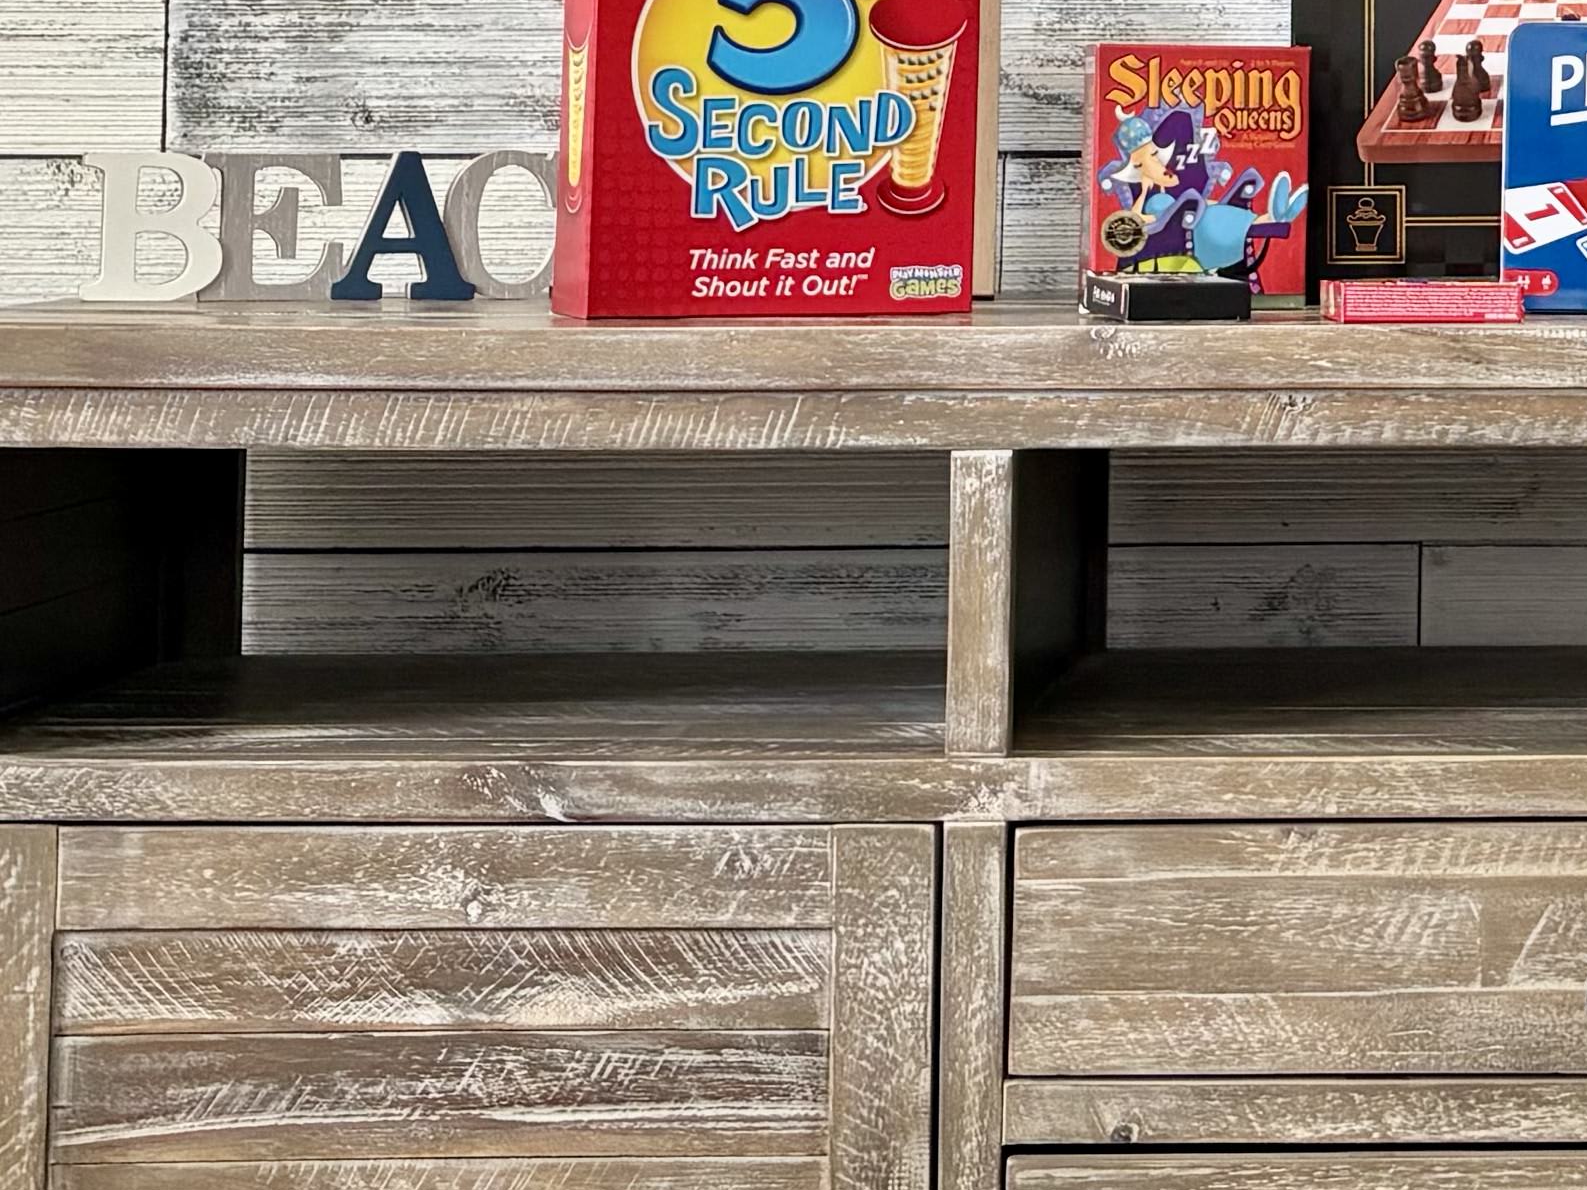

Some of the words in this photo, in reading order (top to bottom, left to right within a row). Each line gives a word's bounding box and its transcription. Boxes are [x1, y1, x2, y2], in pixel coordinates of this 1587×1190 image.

[648, 67, 915, 160] SECOND
[1104, 54, 1302, 141] Sleeping
[1214, 107, 1293, 139] Queens
[690, 156, 866, 233] RULE
[688, 248, 759, 271] Think
[765, 248, 820, 270] Fast
[826, 247, 876, 269] and
[691, 276, 774, 298] Shout
[775, 275, 796, 297] it
